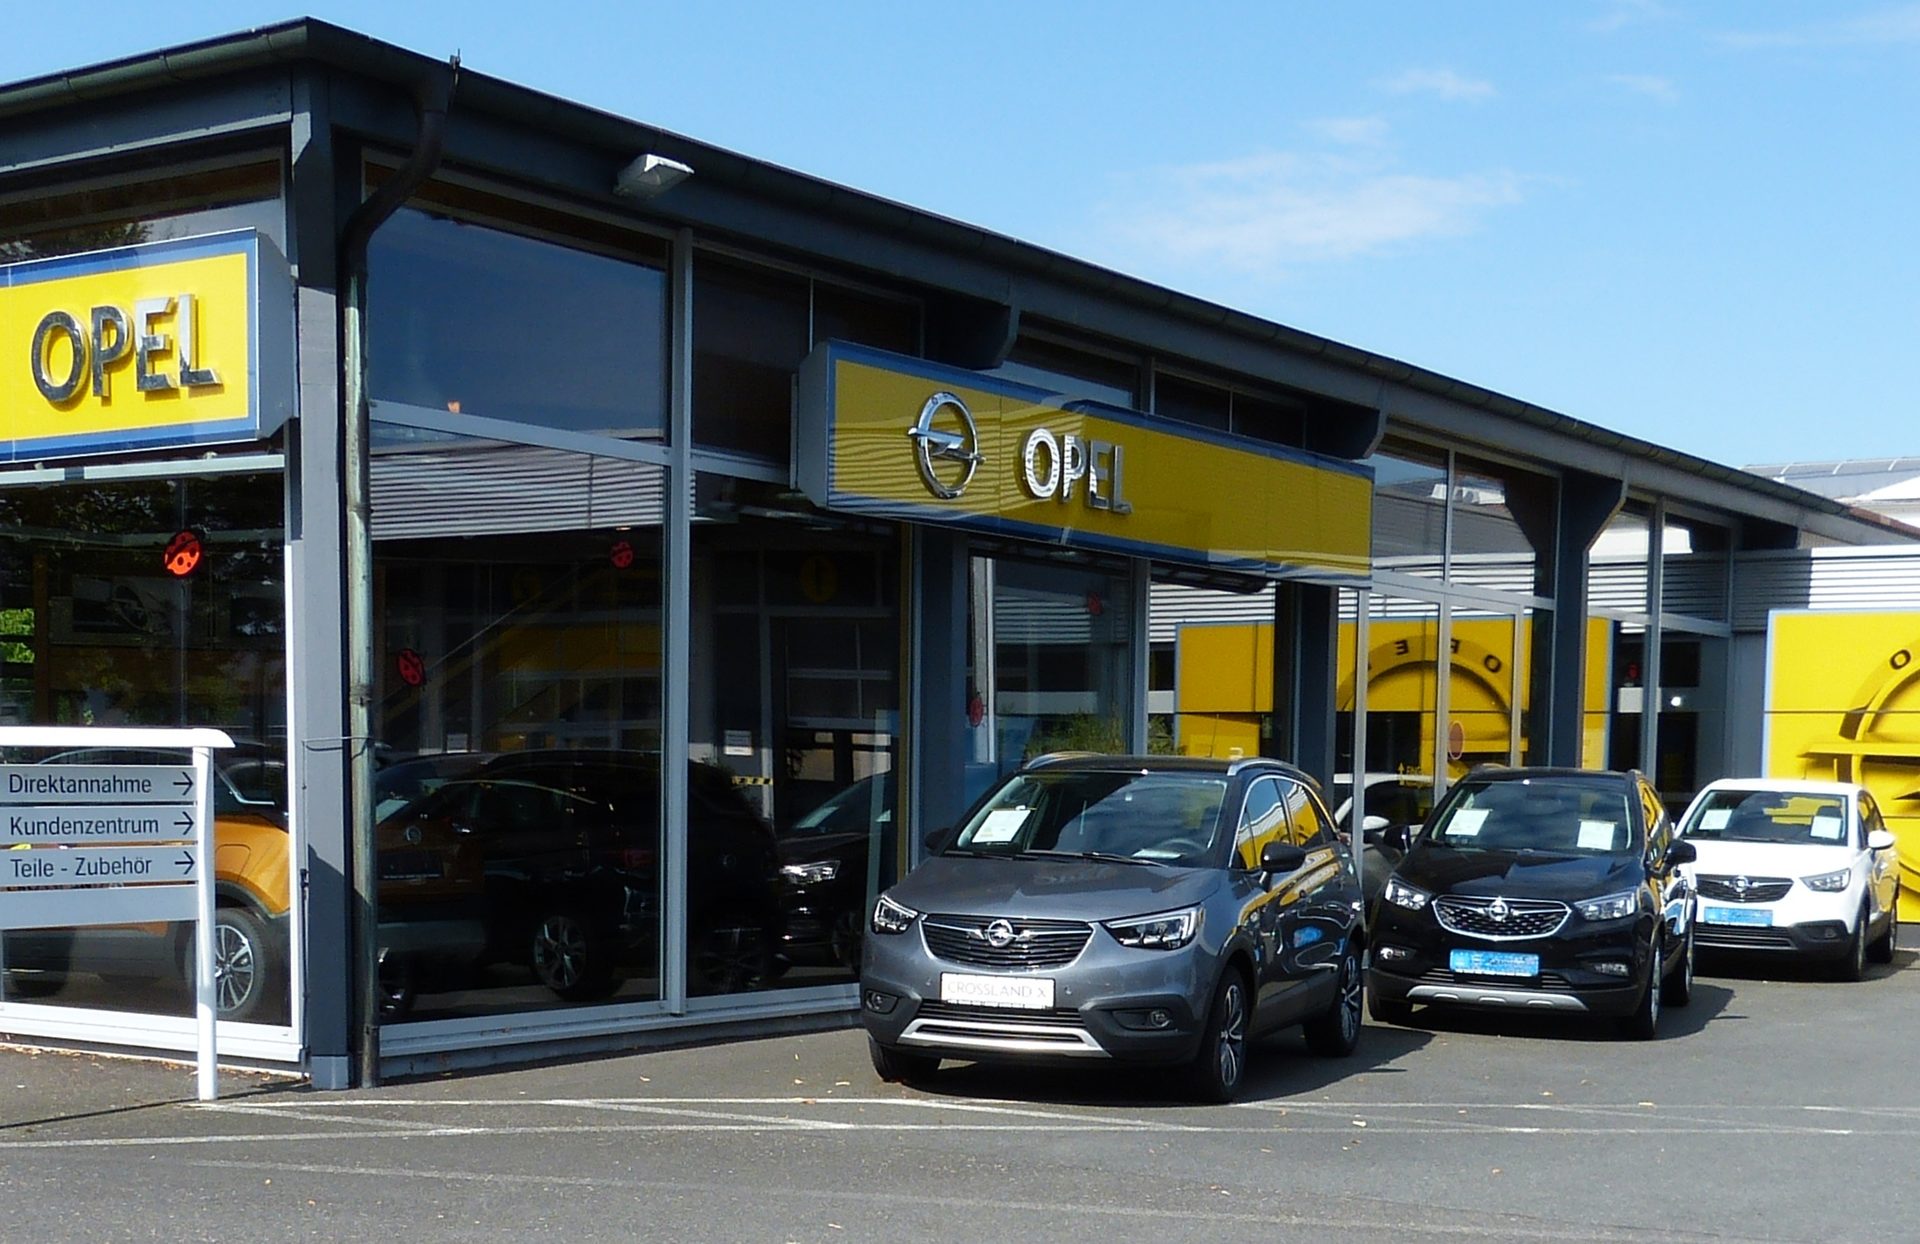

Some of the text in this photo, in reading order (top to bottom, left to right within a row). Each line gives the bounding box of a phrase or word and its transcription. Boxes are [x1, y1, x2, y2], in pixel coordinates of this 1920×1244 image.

[31, 294, 221, 401] OPEL
[1024, 428, 1133, 514] OPEL
[8, 772, 152, 794] Direktannahme
[9, 816, 159, 836] Kundenzentrum
[10, 858, 55, 878] Teile
[74, 856, 152, 877] Zubehör
[947, 981, 1047, 998] CROSSLAND X
